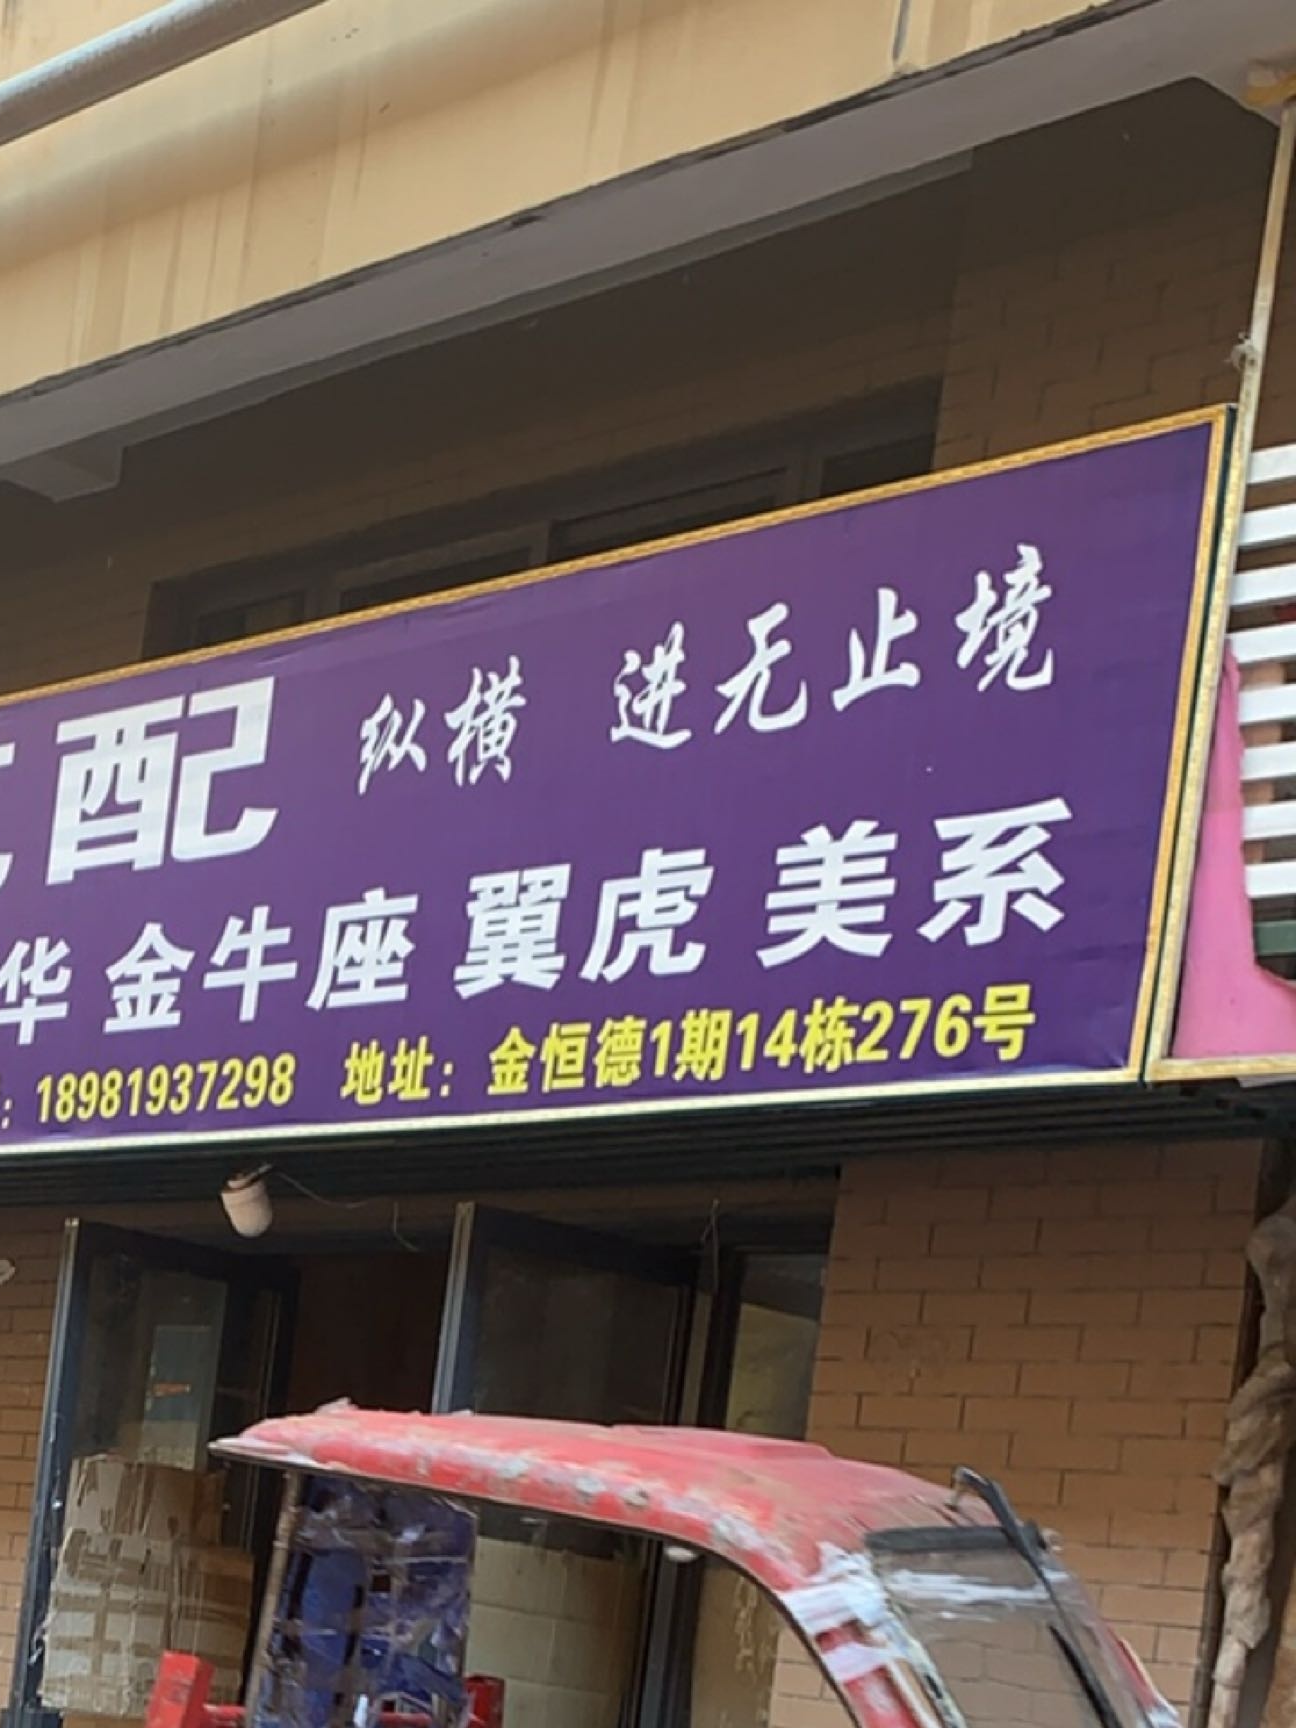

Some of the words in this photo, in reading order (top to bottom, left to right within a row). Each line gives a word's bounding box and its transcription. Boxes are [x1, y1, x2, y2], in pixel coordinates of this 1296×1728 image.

[357, 655, 528, 797] 纵横
[609, 543, 1054, 750] 进无止境
[102, 886, 421, 1035] 金牛座
[452, 846, 716, 1000] 翼虎
[755, 796, 1073, 969] 美系
